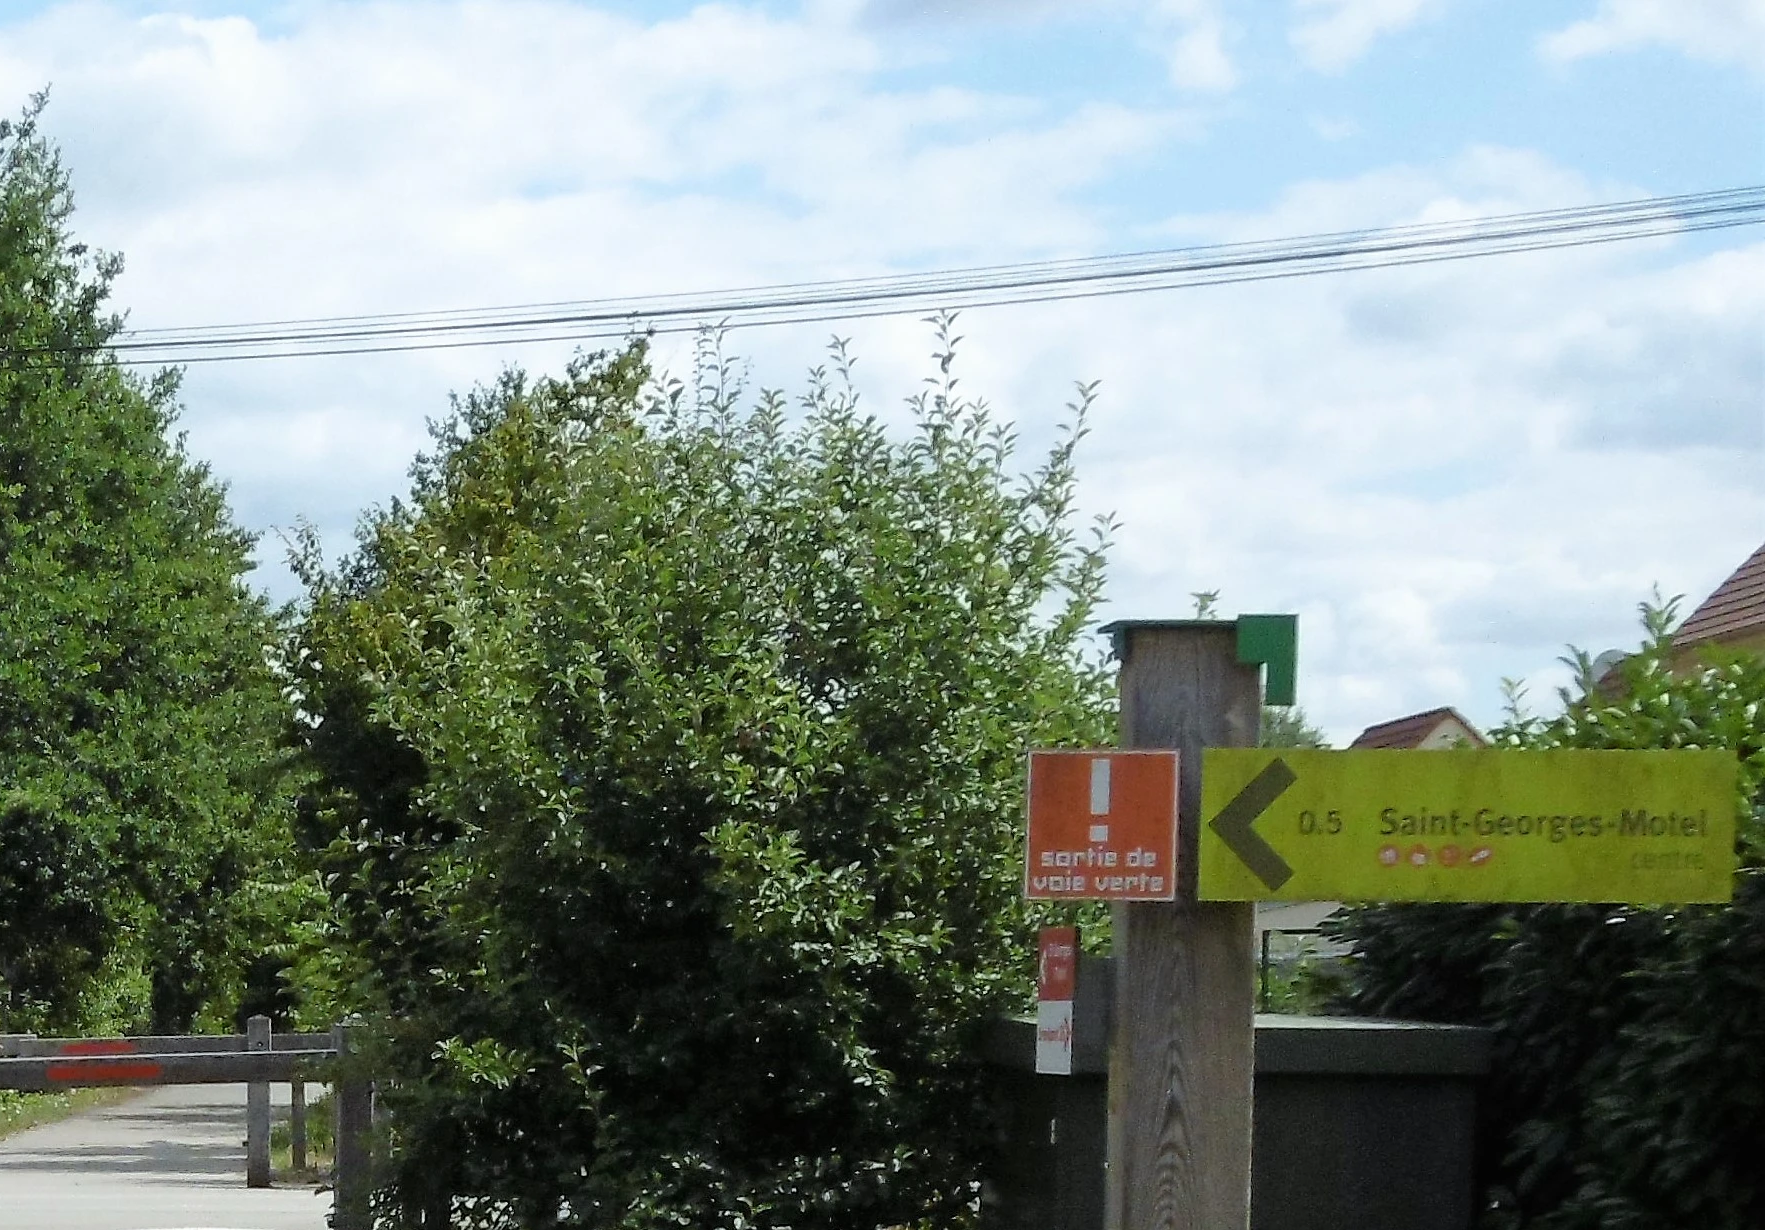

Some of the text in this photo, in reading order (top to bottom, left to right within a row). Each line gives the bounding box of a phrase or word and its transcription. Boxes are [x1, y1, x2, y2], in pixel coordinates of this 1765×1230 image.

[1299, 807, 1709, 844] 0.5 Saint-Georges-Motel
[1041, 846, 1157, 867] sortie de
[1033, 870, 1164, 892] voie verte
